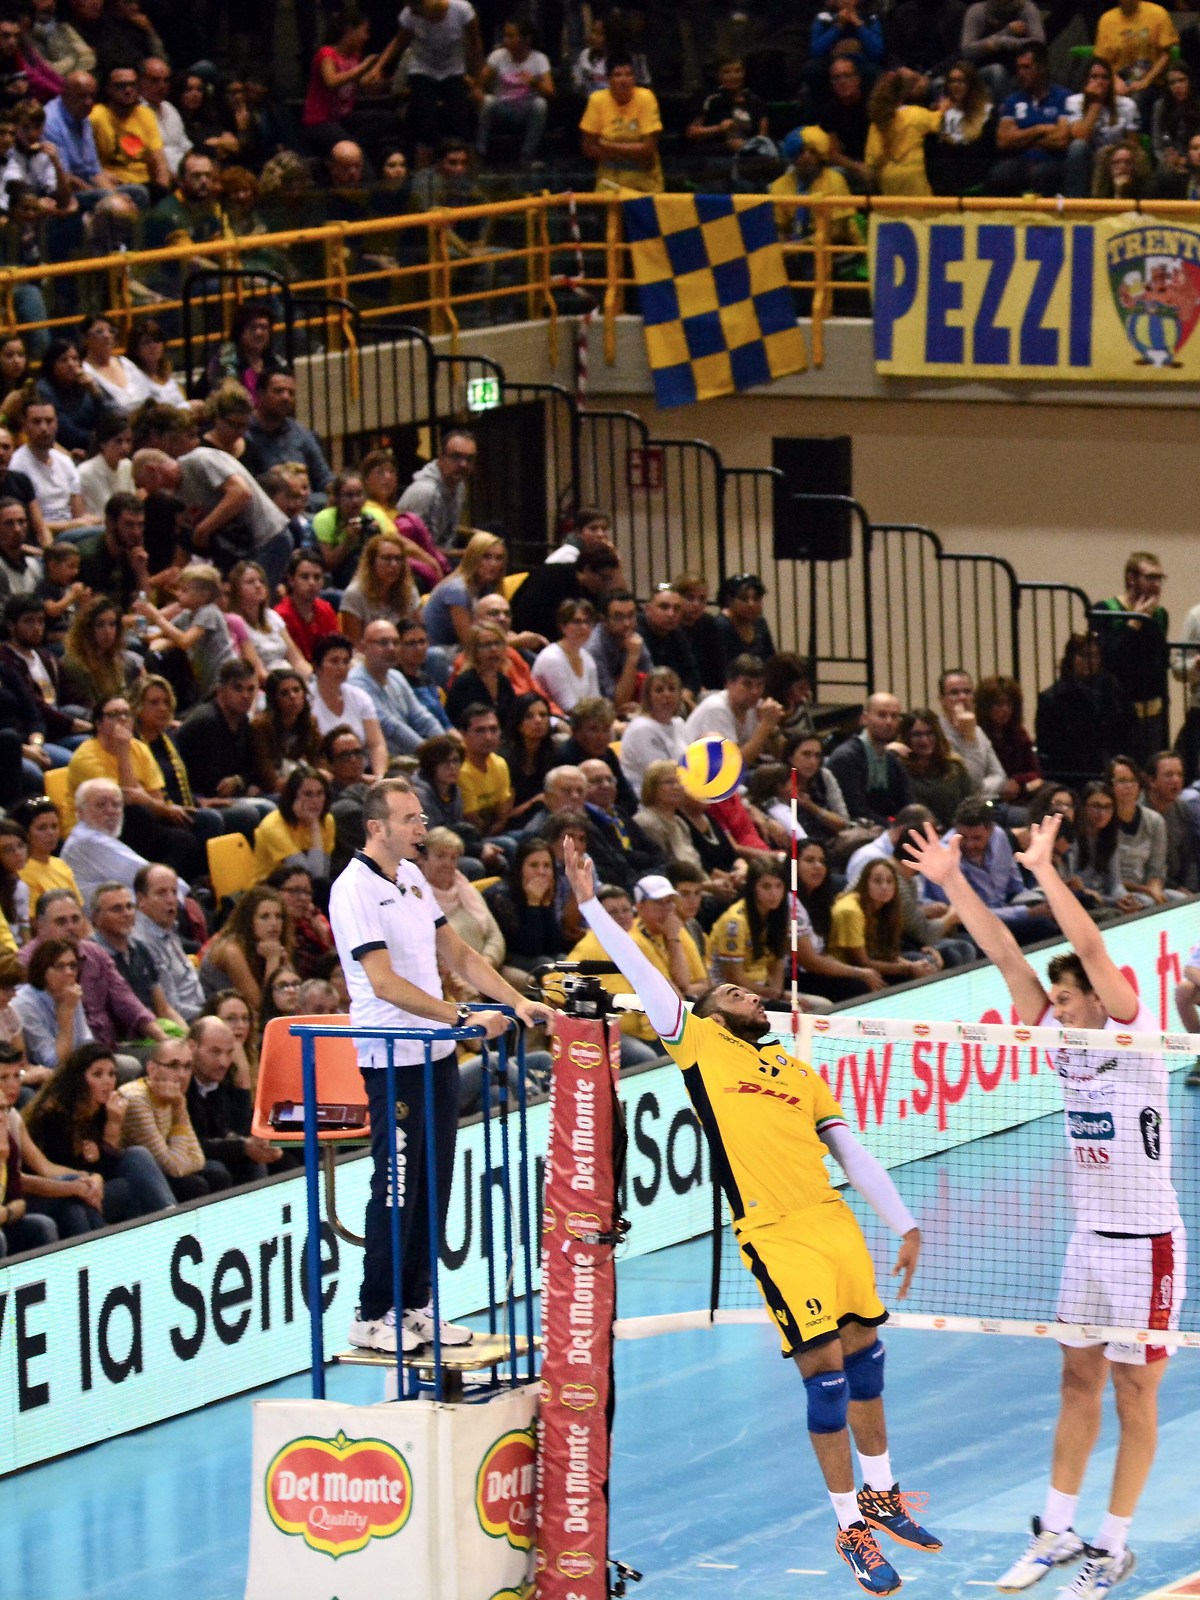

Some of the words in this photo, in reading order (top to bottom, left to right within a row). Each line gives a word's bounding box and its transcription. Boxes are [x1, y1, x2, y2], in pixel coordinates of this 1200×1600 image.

[873, 221, 1094, 367] PEZZI
[571, 1078, 596, 1152] Monte
[571, 1155, 596, 1191] Del
[569, 1252, 596, 1325] Monte
[806, 1297, 822, 1316] 9
[0, 1278, 51, 1413] E
[77, 1266, 143, 1392] la
[168, 1203, 341, 1362] Serie
[567, 1329, 593, 1365] Del
[565, 1423, 591, 1494] Monte
[276, 1470, 319, 1502] Del
[321, 1471, 404, 1505] Monte
[486, 1465, 519, 1502] Del
[308, 1504, 369, 1532] Quality
[564, 1497, 590, 1534] Del
